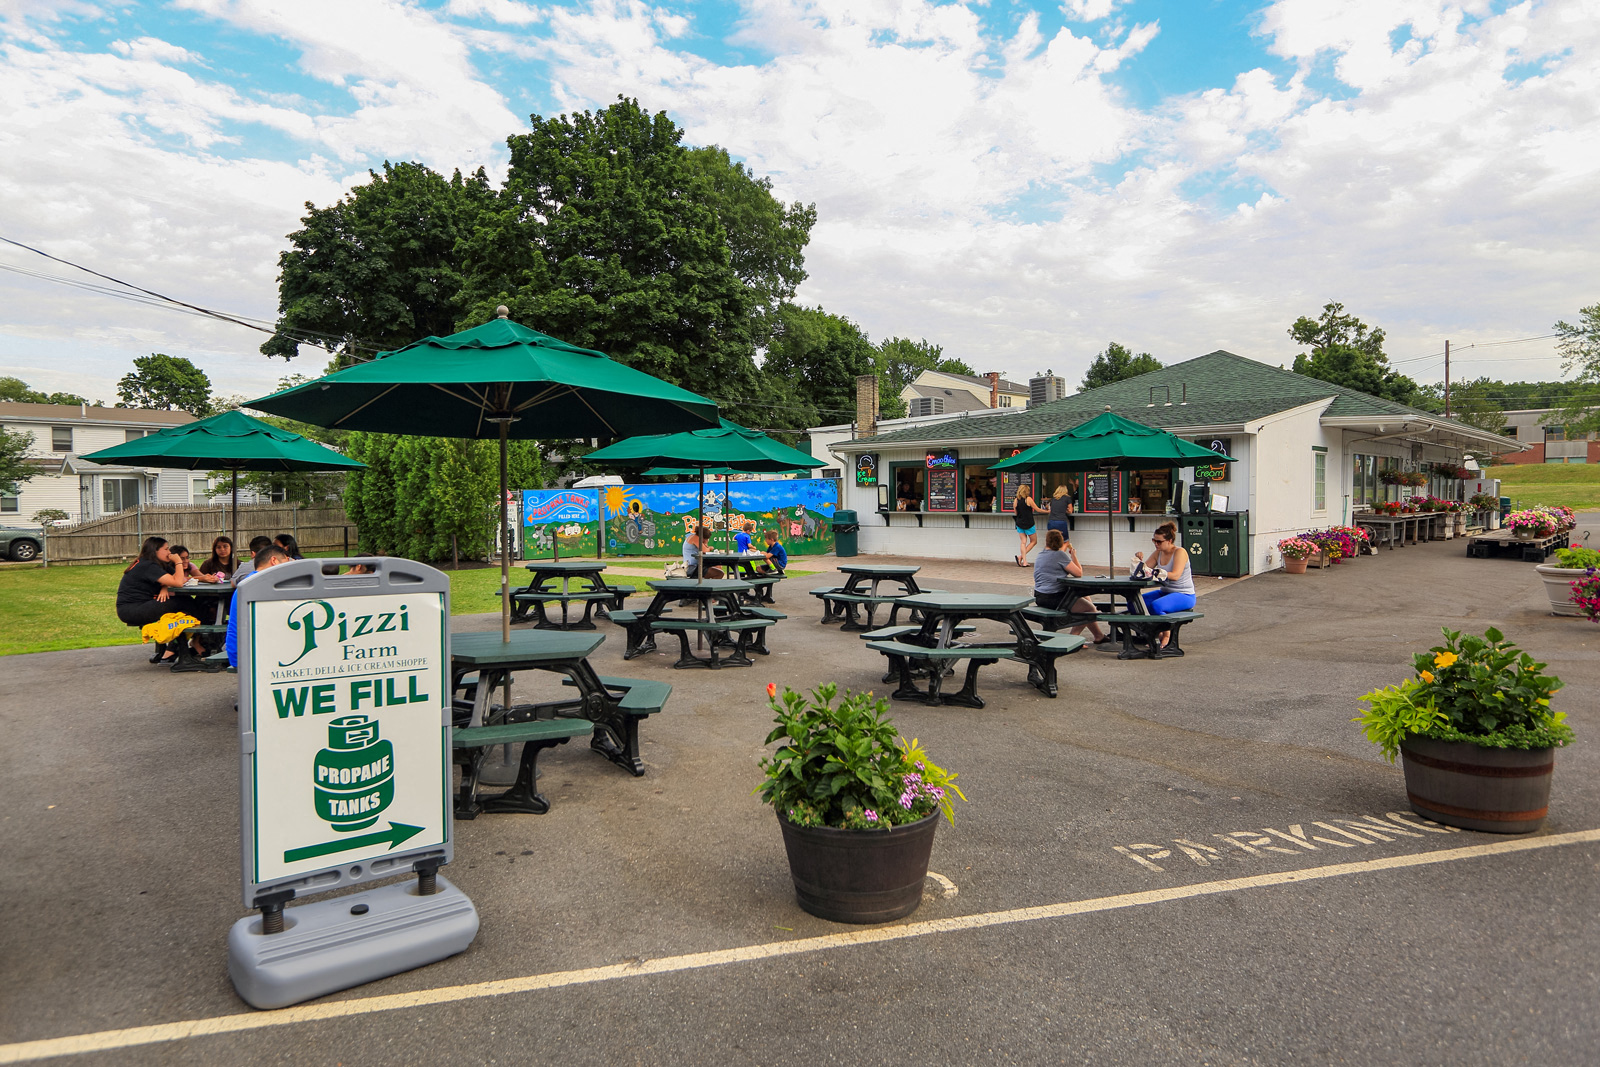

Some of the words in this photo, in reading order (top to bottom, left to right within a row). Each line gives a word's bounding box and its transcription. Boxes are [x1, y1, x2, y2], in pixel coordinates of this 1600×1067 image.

[857, 475, 877, 483] Cream
[1195, 469, 1224, 478] Cream
[533, 495, 565, 517] PROPANE
[565, 494, 590, 508] TANKS
[278, 600, 410, 668] Pizzi
[342, 644, 398, 661] Farm
[315, 665, 336, 675] DELI
[338, 665, 345, 673] &
[347, 662, 362, 672] ICE
[364, 660, 395, 671] CREAM
[396, 657, 428, 668] SHOPPE
[272, 683, 336, 719] WE
[350, 675, 429, 710] FILL
[318, 754, 390, 785] PROPANE
[328, 791, 381, 816] TANKS
